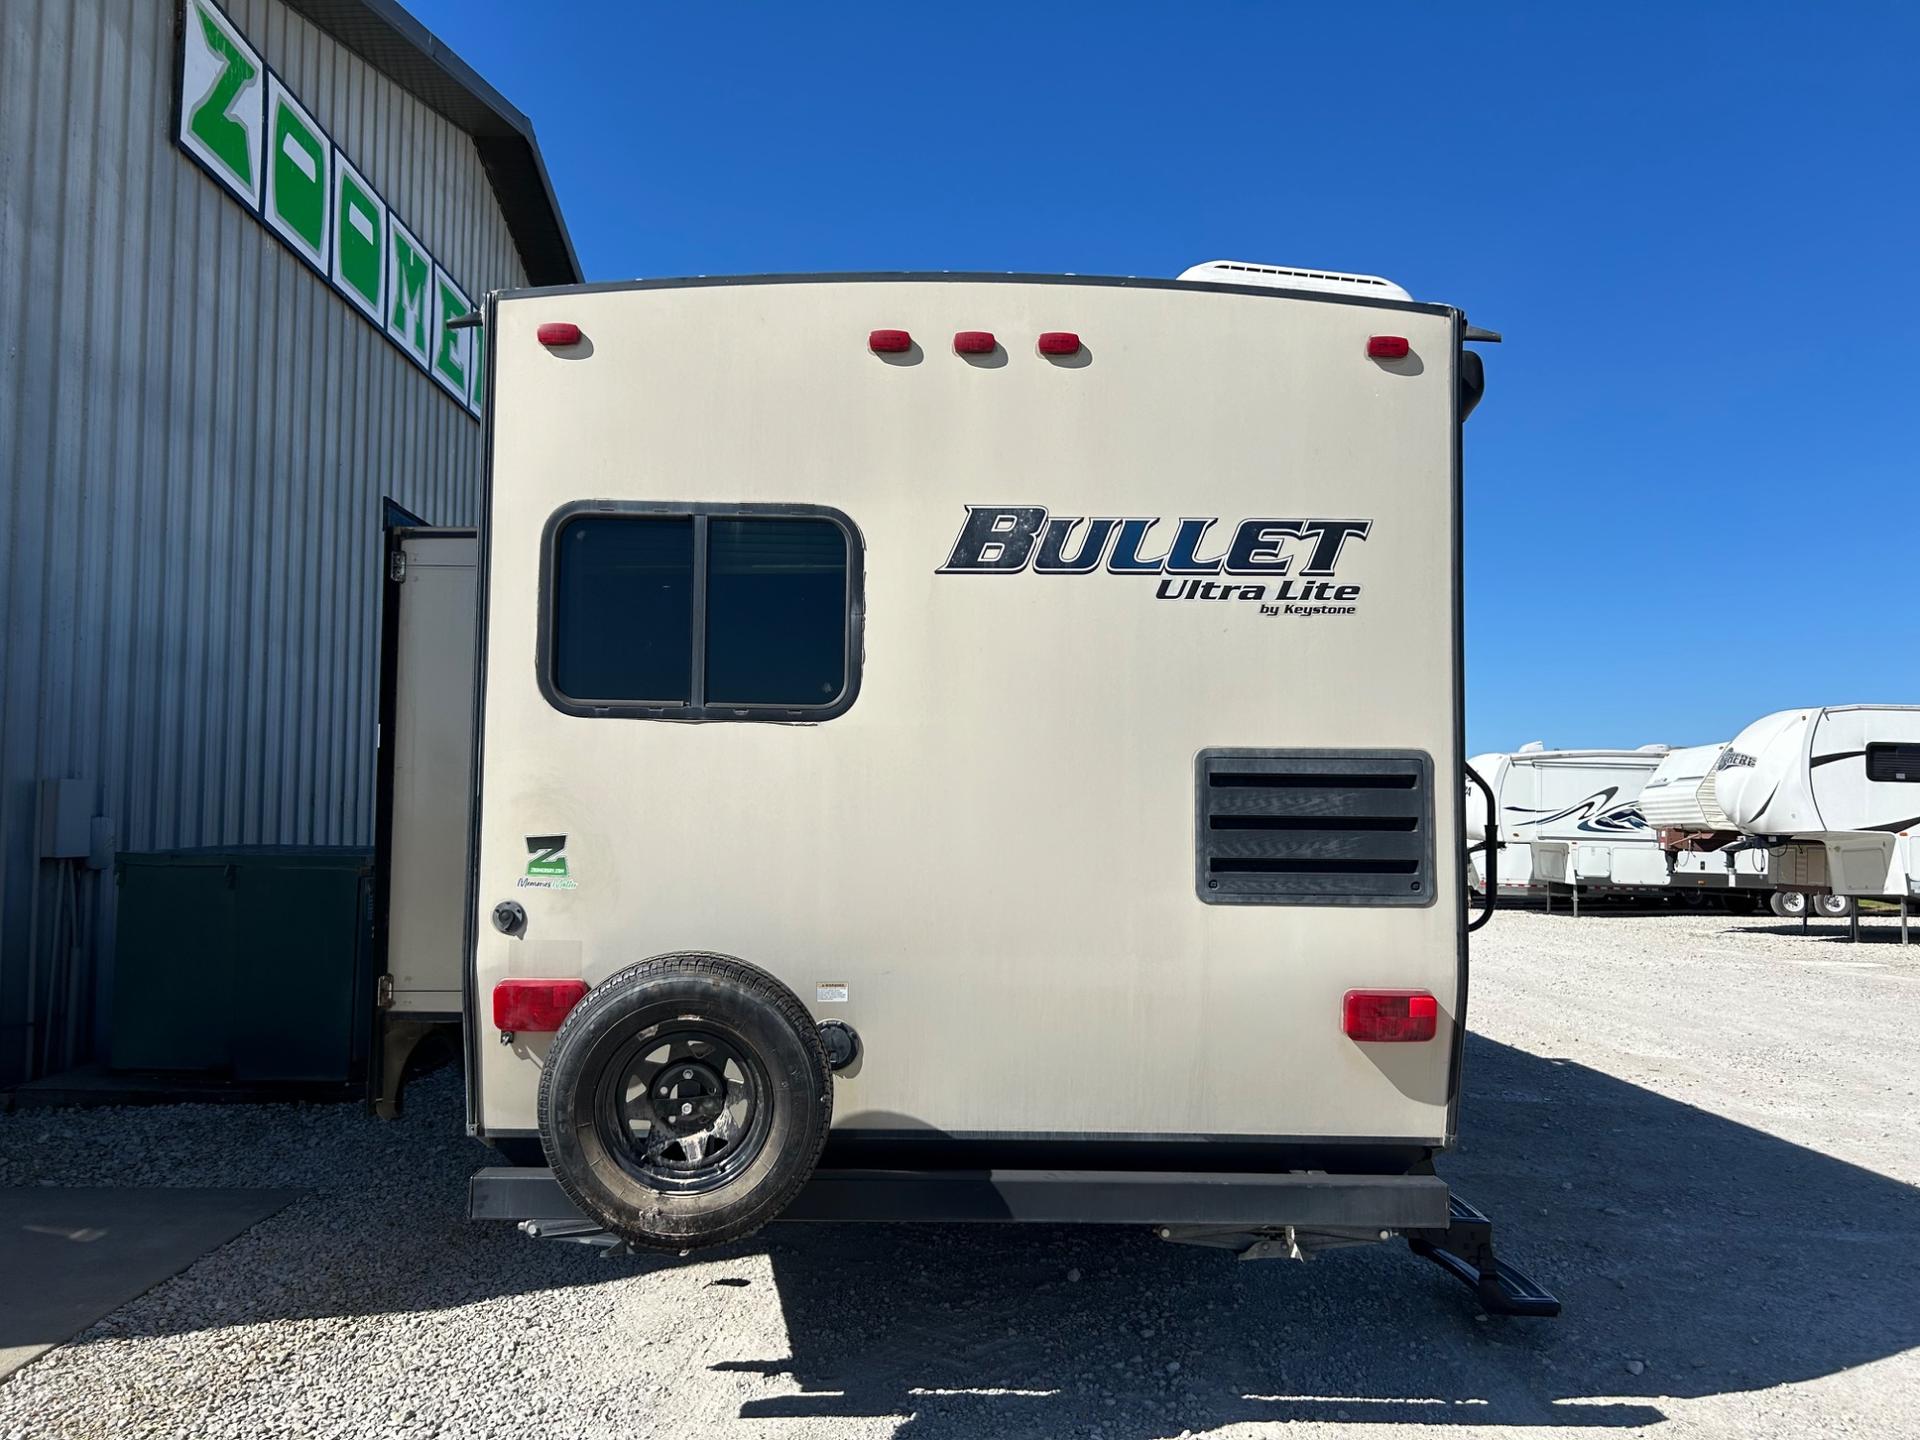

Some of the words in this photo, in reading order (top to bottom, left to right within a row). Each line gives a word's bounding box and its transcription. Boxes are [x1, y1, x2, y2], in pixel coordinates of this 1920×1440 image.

[934, 504, 1374, 576] BULLET
[1156, 579, 1266, 601] Ultra
[1275, 580, 1361, 601] Lite
[1260, 604, 1279, 616] by
[1284, 604, 1356, 617] Keystone
